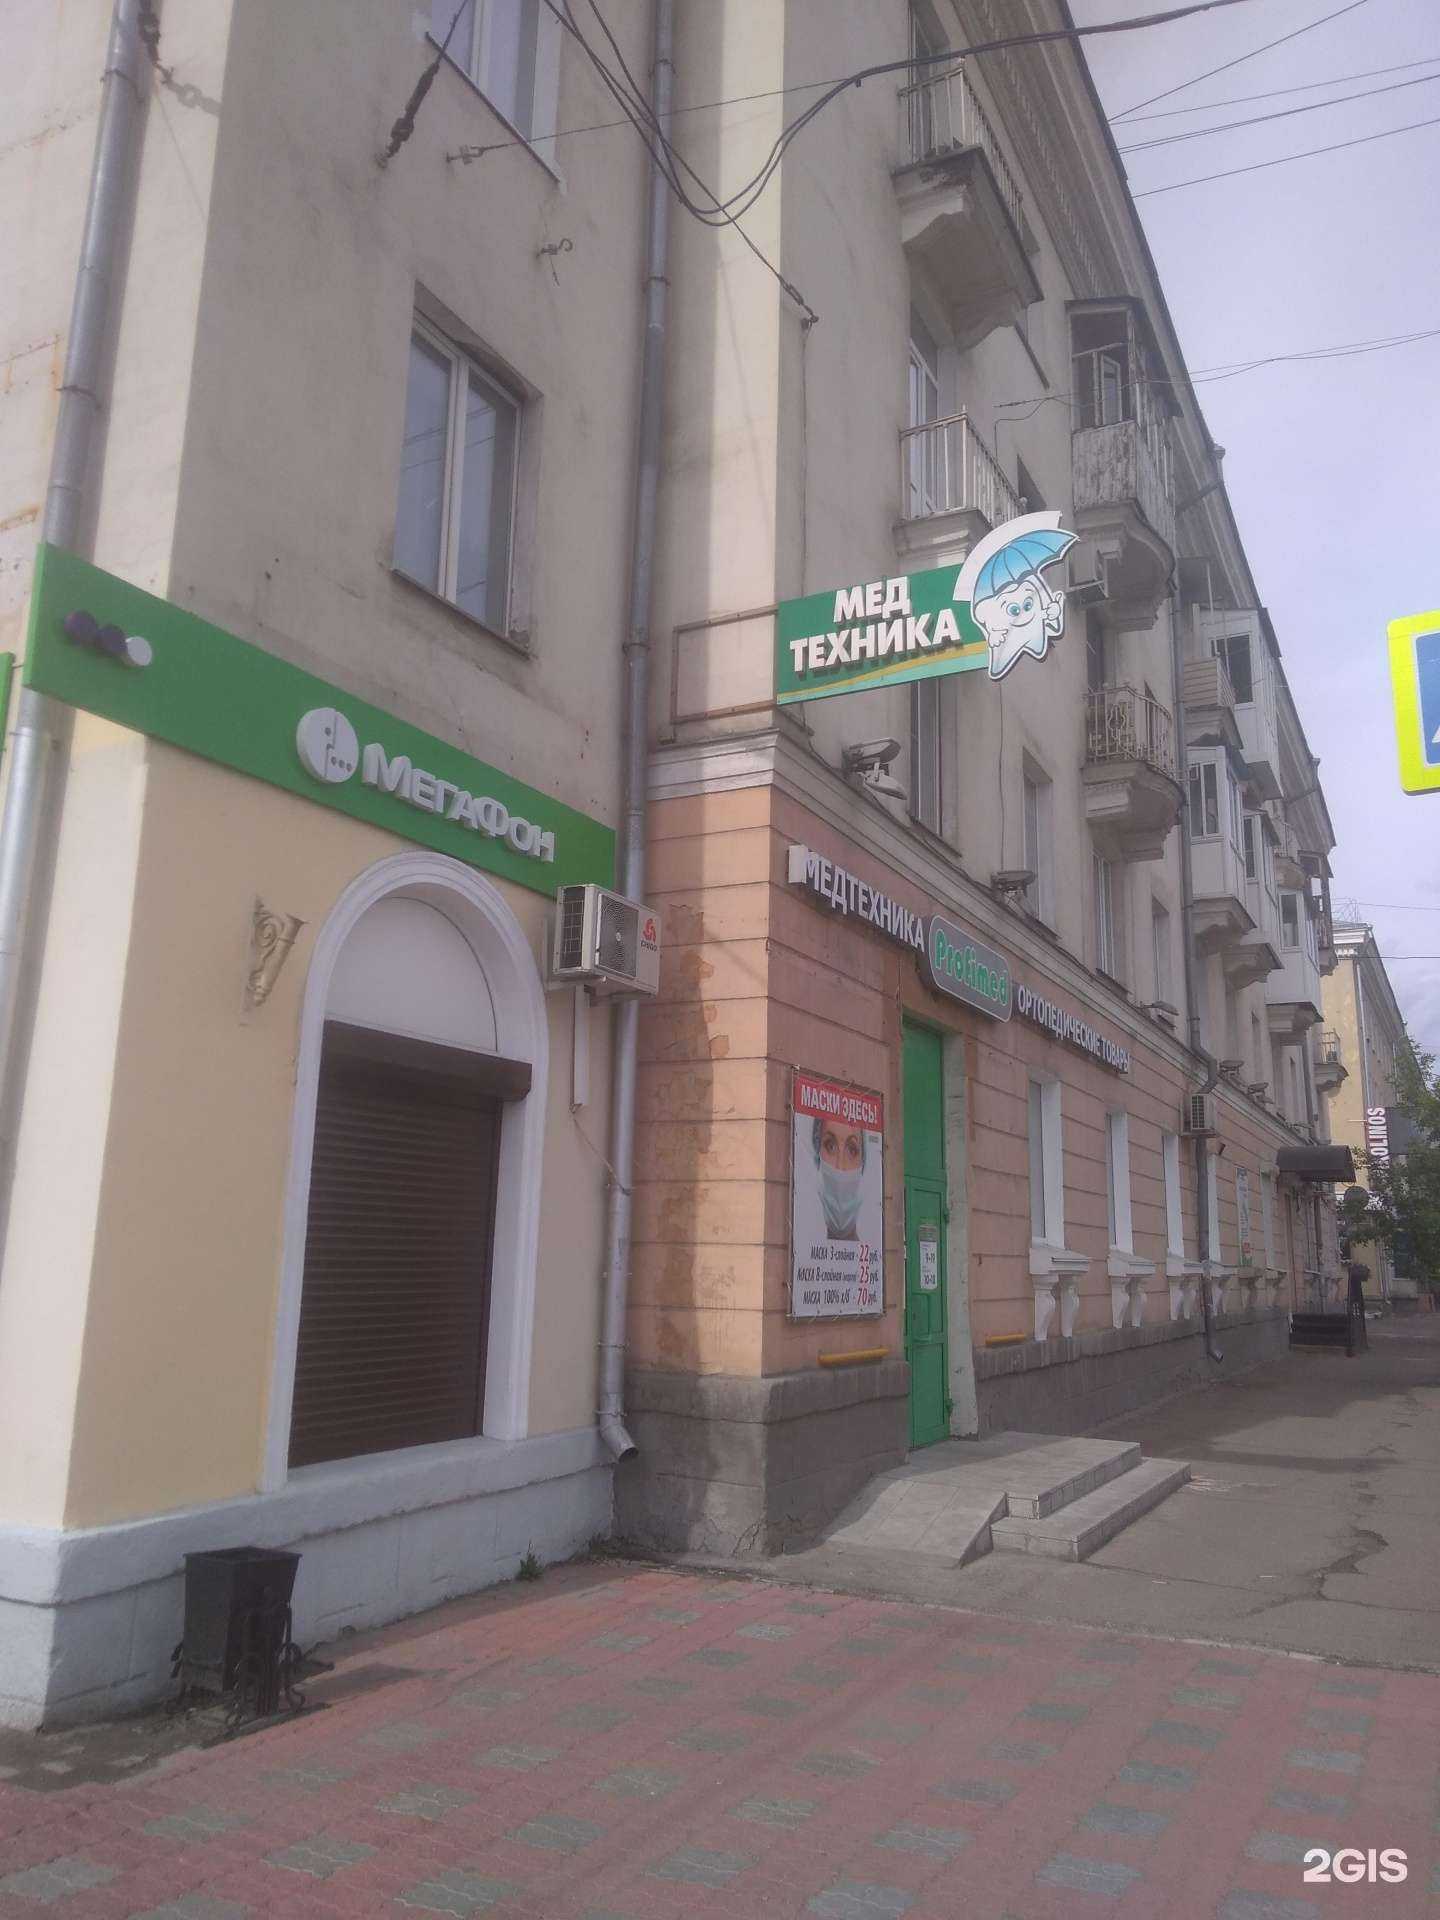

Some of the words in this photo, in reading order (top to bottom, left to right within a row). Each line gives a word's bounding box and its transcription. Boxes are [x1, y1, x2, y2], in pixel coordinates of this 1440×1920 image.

[833, 576, 911, 624] МЕД
[789, 608, 962, 672] ТЕХНИКА
[788, 844, 925, 953] МЕДТЕХНИКА
[935, 928, 1008, 1007] Profimed
[1018, 985, 1101, 1057] ОРТОПЕДИЧЕСКИЕ
[1101, 1036, 1130, 1072] ТОВАРЫ
[801, 1084, 840, 1115] МАСКИ
[842, 1096, 878, 1124] ЗДЕСЬ!
[797, 1267, 815, 1281] МАСКА
[859, 1265, 869, 1283] 25
[810, 1246, 828, 1260] МАСКА
[859, 1244, 869, 1262] 22
[802, 1290, 820, 1304] МАСКА
[858, 1287, 868, 1305] 70
